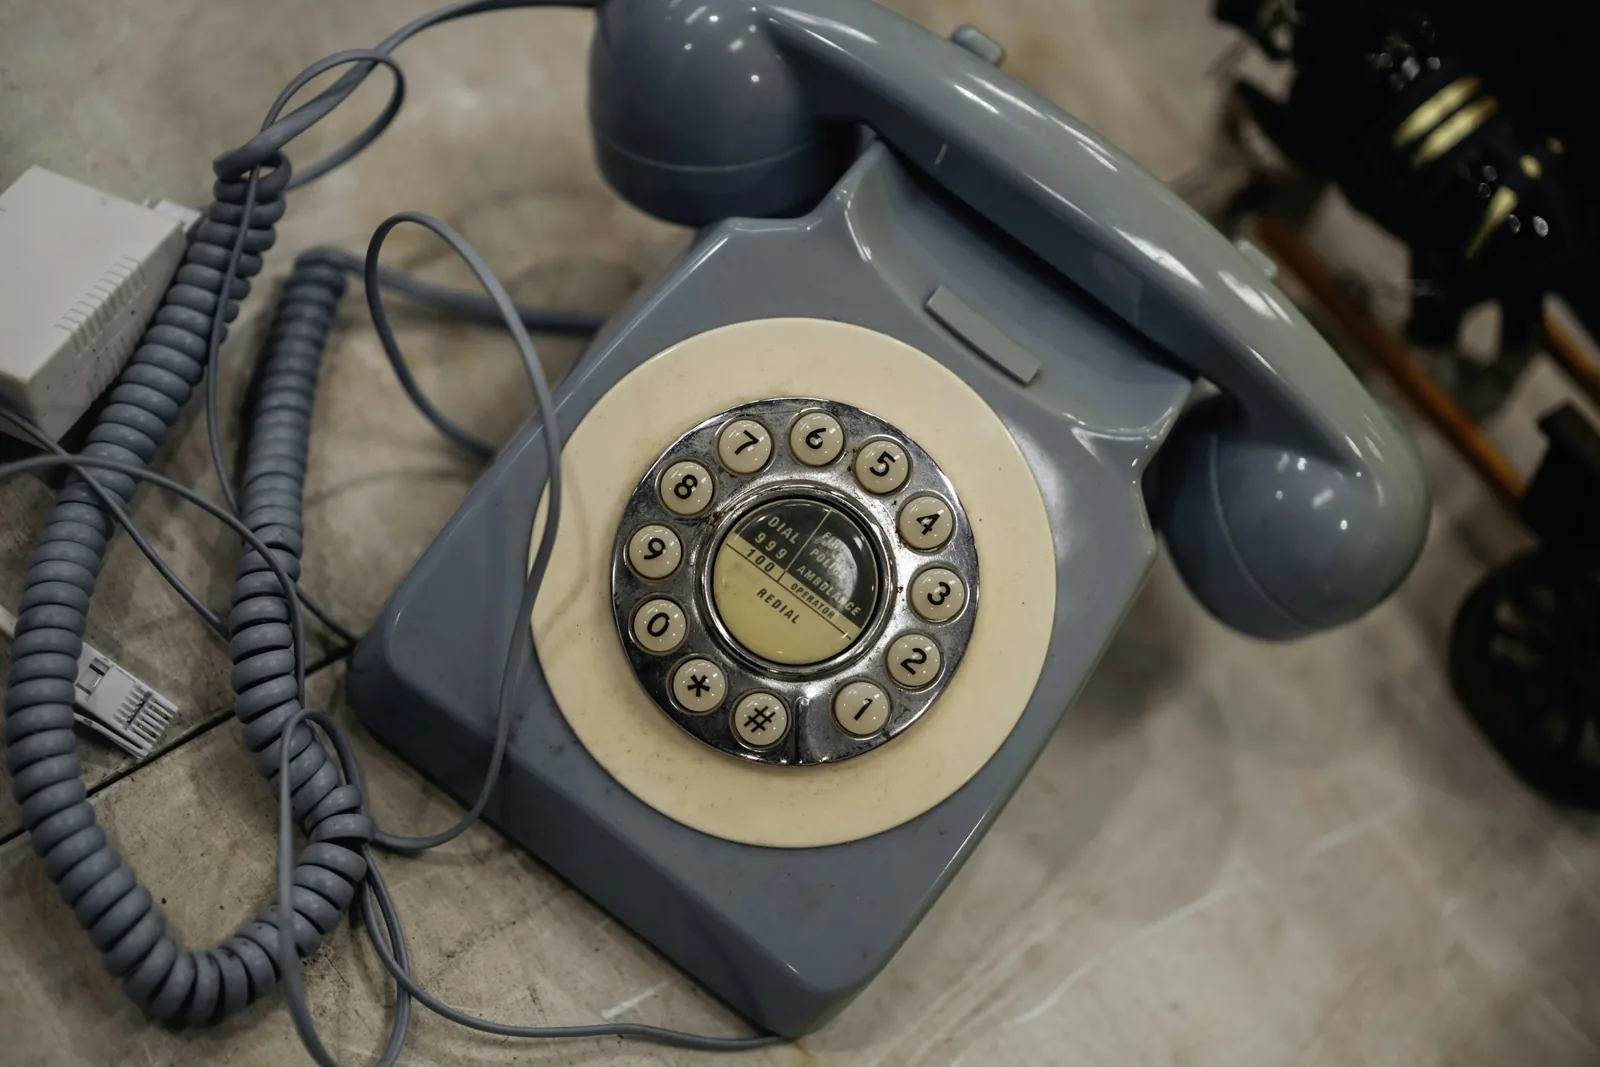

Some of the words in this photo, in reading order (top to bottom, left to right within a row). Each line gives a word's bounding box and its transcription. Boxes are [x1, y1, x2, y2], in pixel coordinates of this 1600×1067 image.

[734, 430, 760, 455] 7
[806, 427, 827, 450] 6
[869, 451, 896, 477] 5
[674, 474, 698, 499] 8
[768, 516, 800, 544] DIAL
[916, 513, 941, 536] 4
[643, 537, 666, 560] 9
[754, 532, 788, 560] 999
[745, 549, 775, 573] 100
[790, 582, 836, 620] OPERATOR
[927, 581, 951, 606] 3
[756, 588, 800, 624] REDIAL
[647, 612, 670, 637] 0
[900, 648, 927, 675] 2
[743, 706, 776, 733] #
[853, 698, 873, 721] 1
